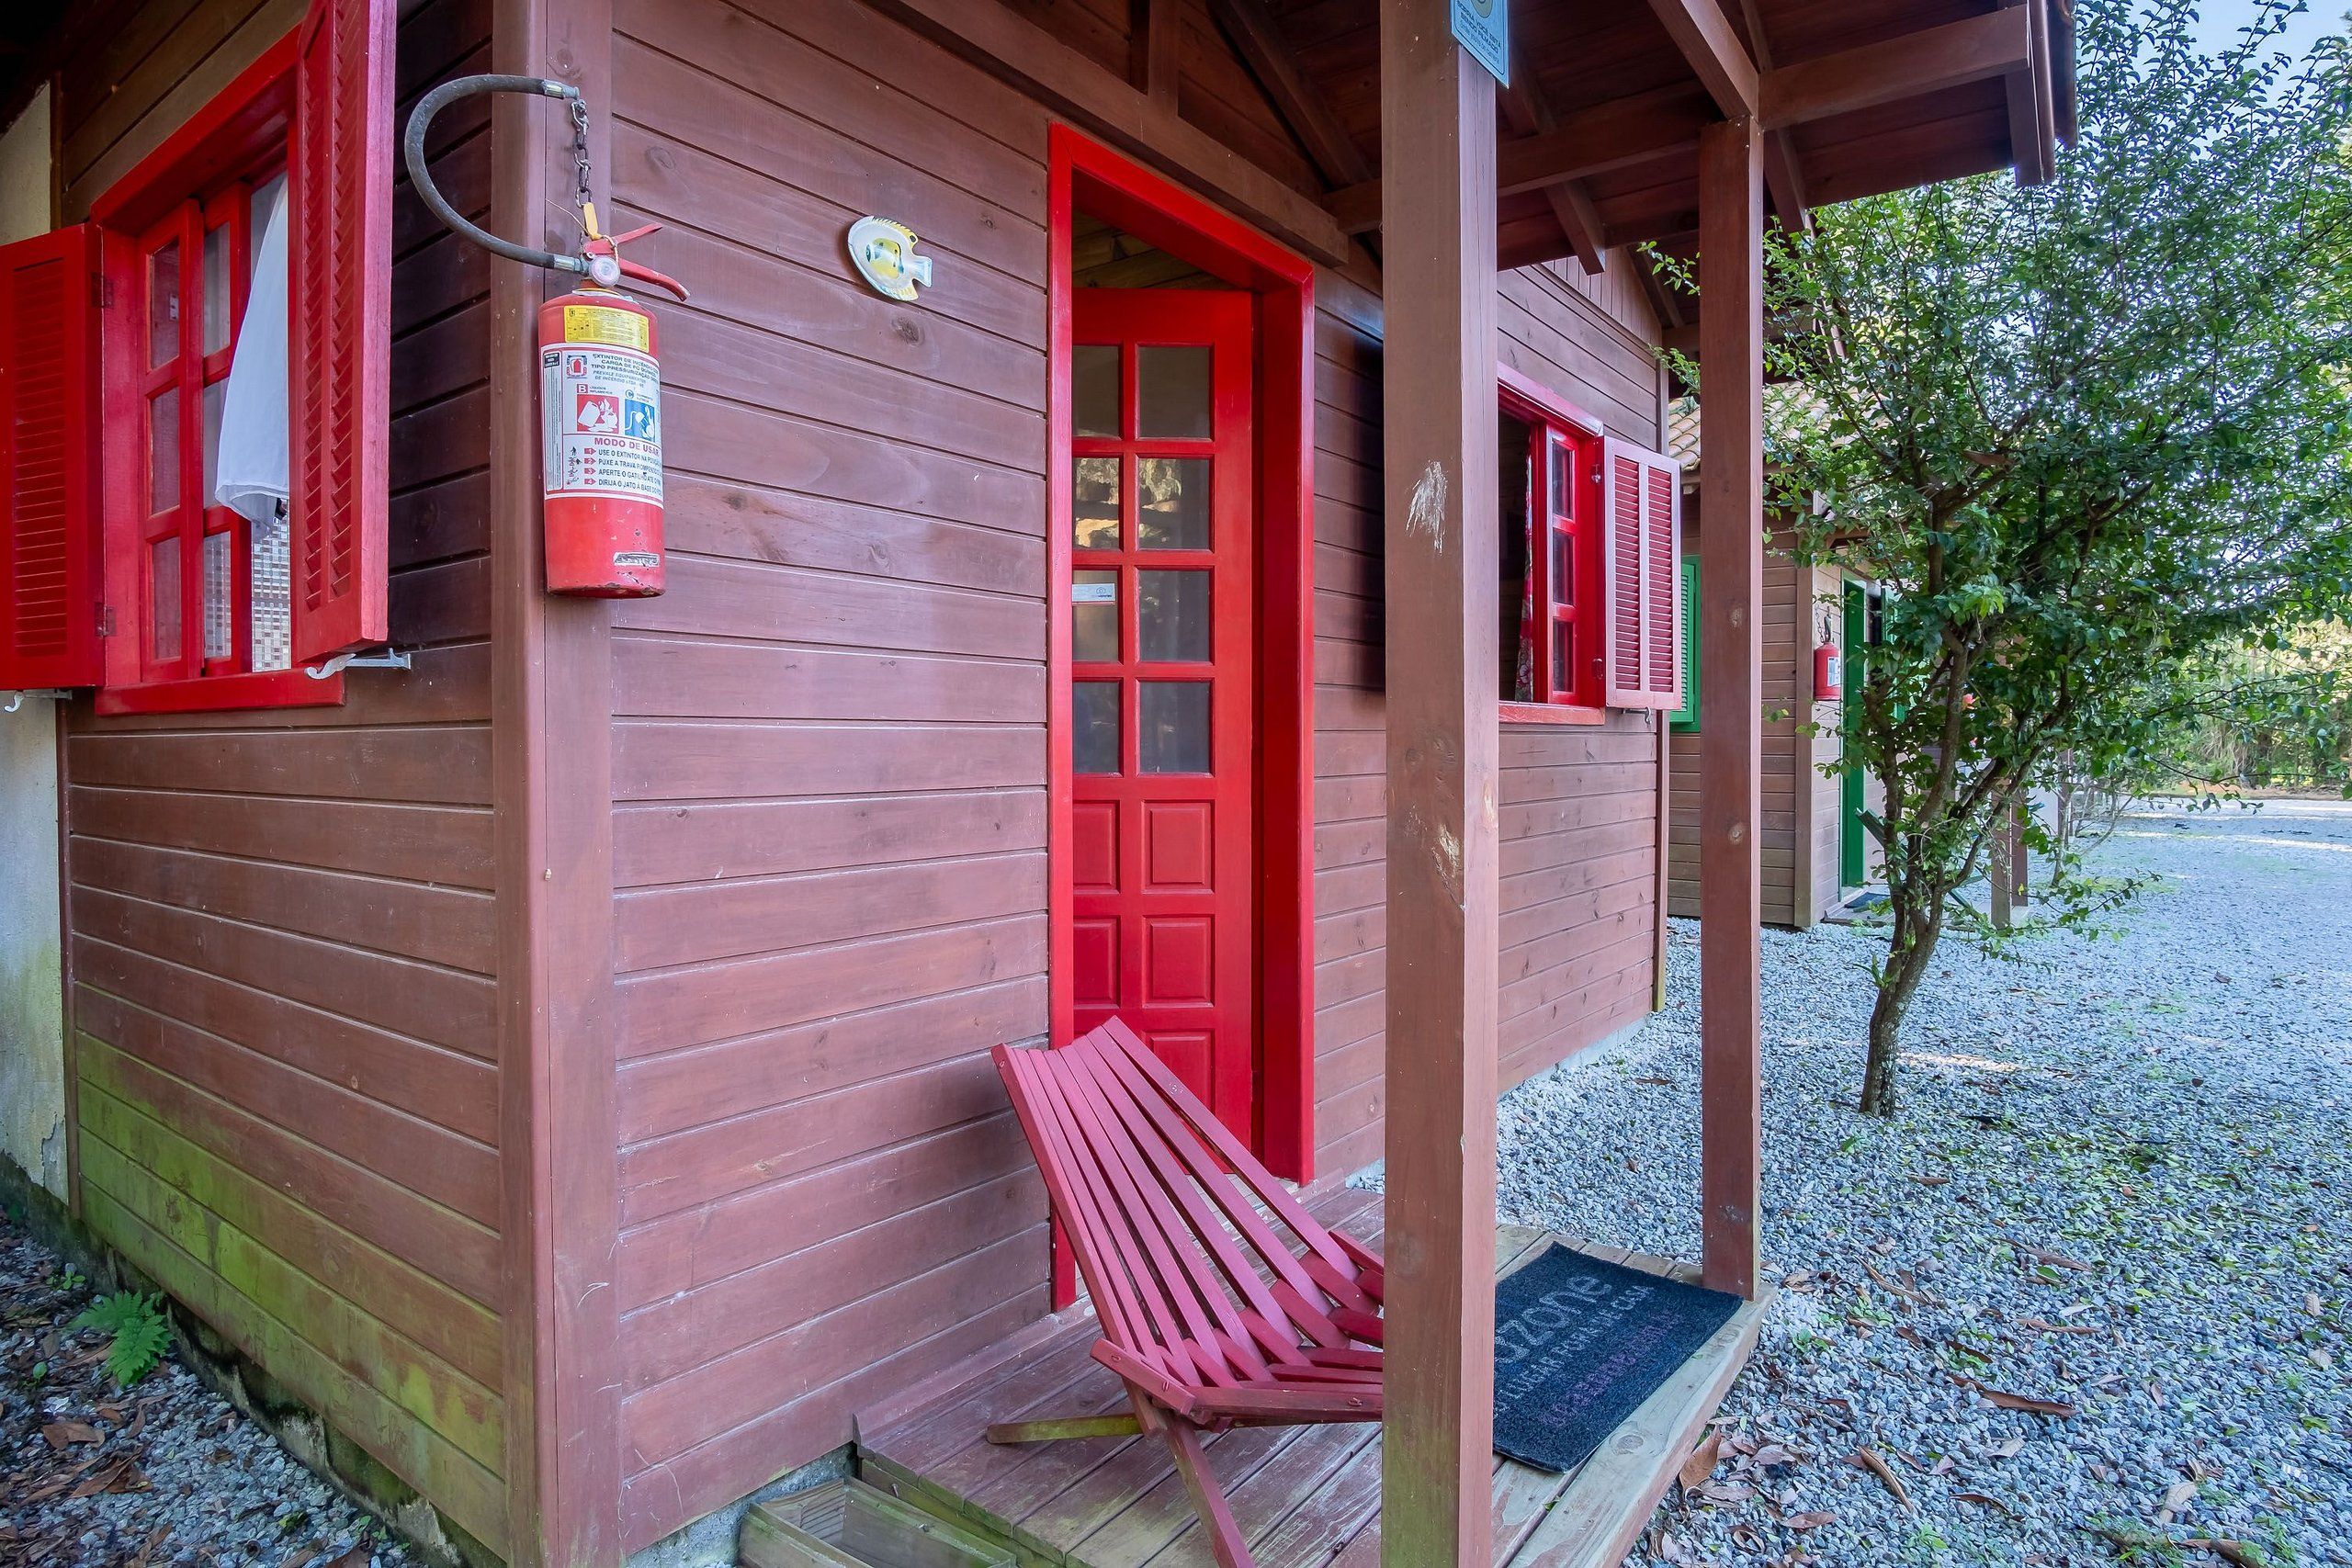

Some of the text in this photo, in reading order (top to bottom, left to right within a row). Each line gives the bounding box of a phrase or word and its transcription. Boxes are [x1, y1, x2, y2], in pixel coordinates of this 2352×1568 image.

[593, 354, 623, 362] EXTINTOR
[579, 384, 586, 393] B
[594, 437, 660, 457] MODO DE USAR
[616, 451, 640, 460] EXTINTOR
[1498, 1356, 1565, 1400] LUGAR
[1550, 1326, 1601, 1359] FORA
[1611, 1285, 1656, 1311] CASA
